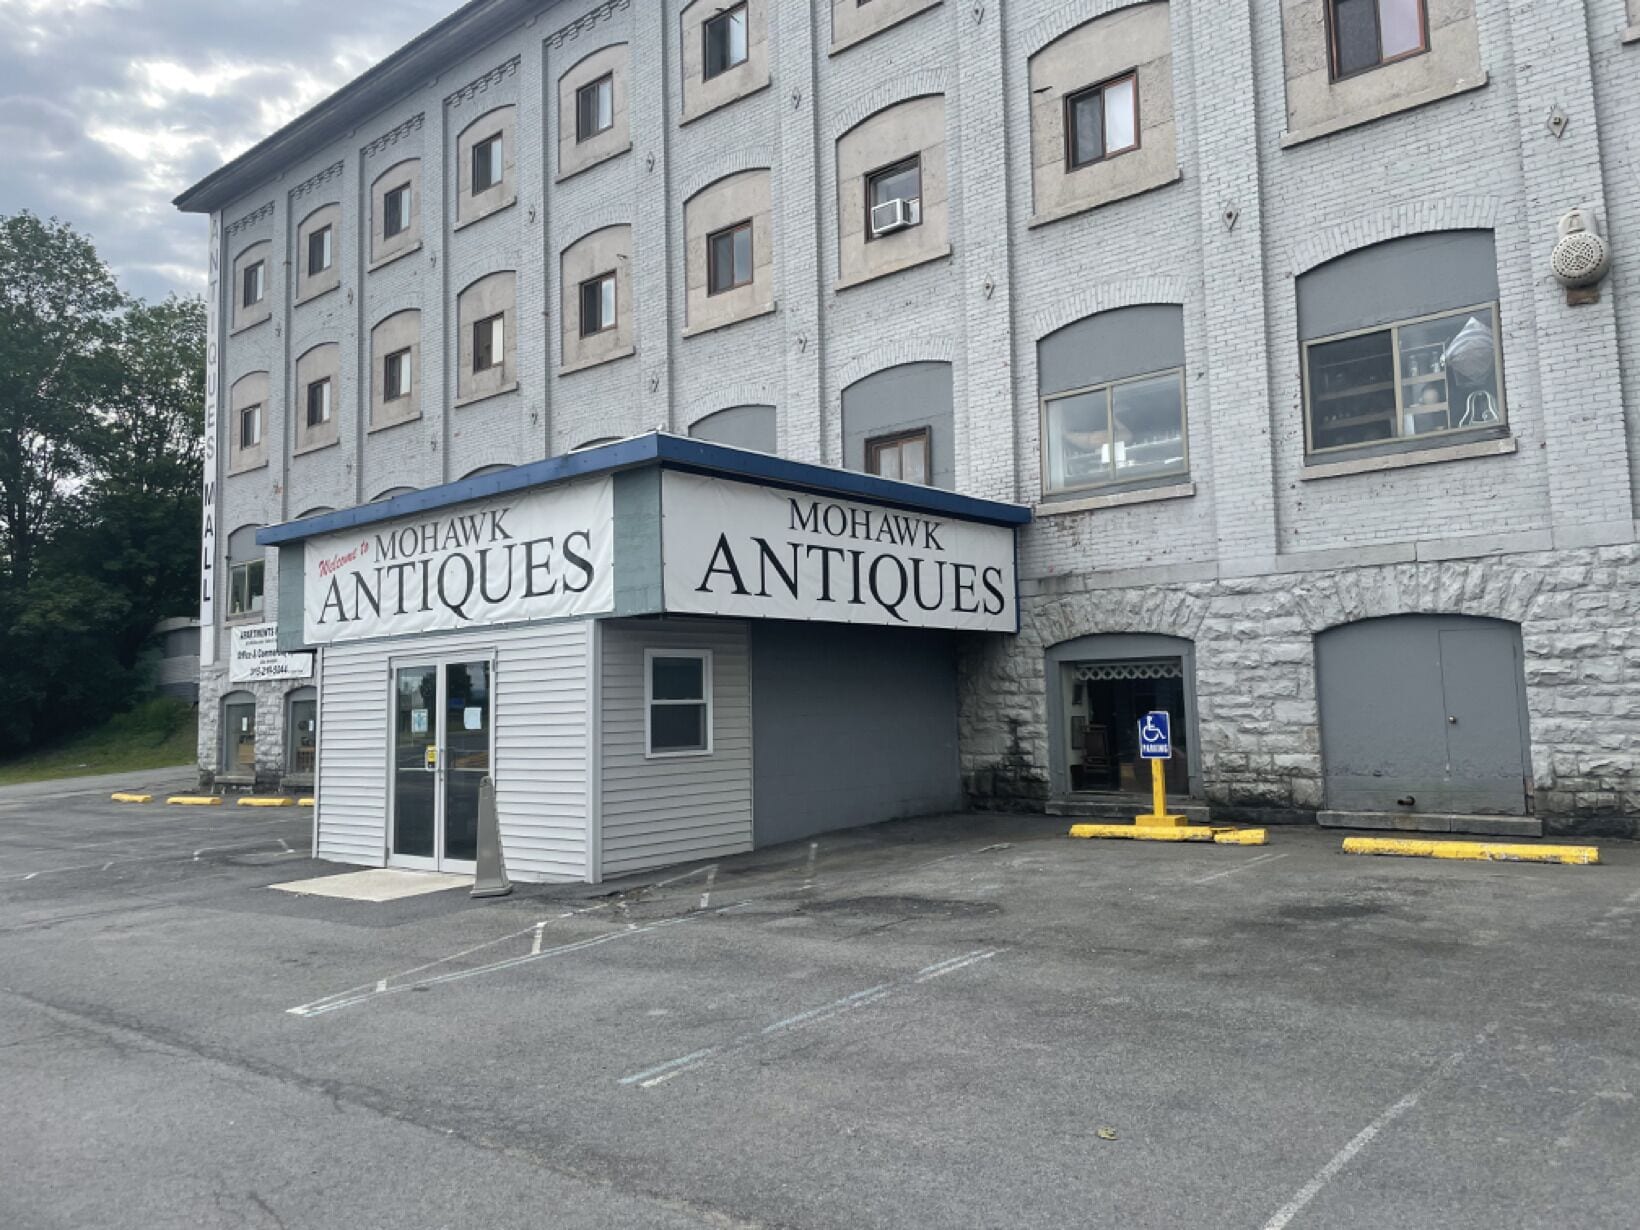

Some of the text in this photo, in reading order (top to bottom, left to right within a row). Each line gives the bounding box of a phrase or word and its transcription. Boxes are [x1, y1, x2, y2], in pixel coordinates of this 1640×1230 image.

[203, 219, 219, 602] ANTIQUES MALL
[373, 508, 513, 564] MOHAWK
[788, 497, 945, 551] MOHAWK
[317, 528, 595, 621] ANTIQUES
[318, 540, 370, 578] Welcome to
[694, 532, 1005, 622] ANTIQUES
[1142, 744, 1168, 753] PARKING
